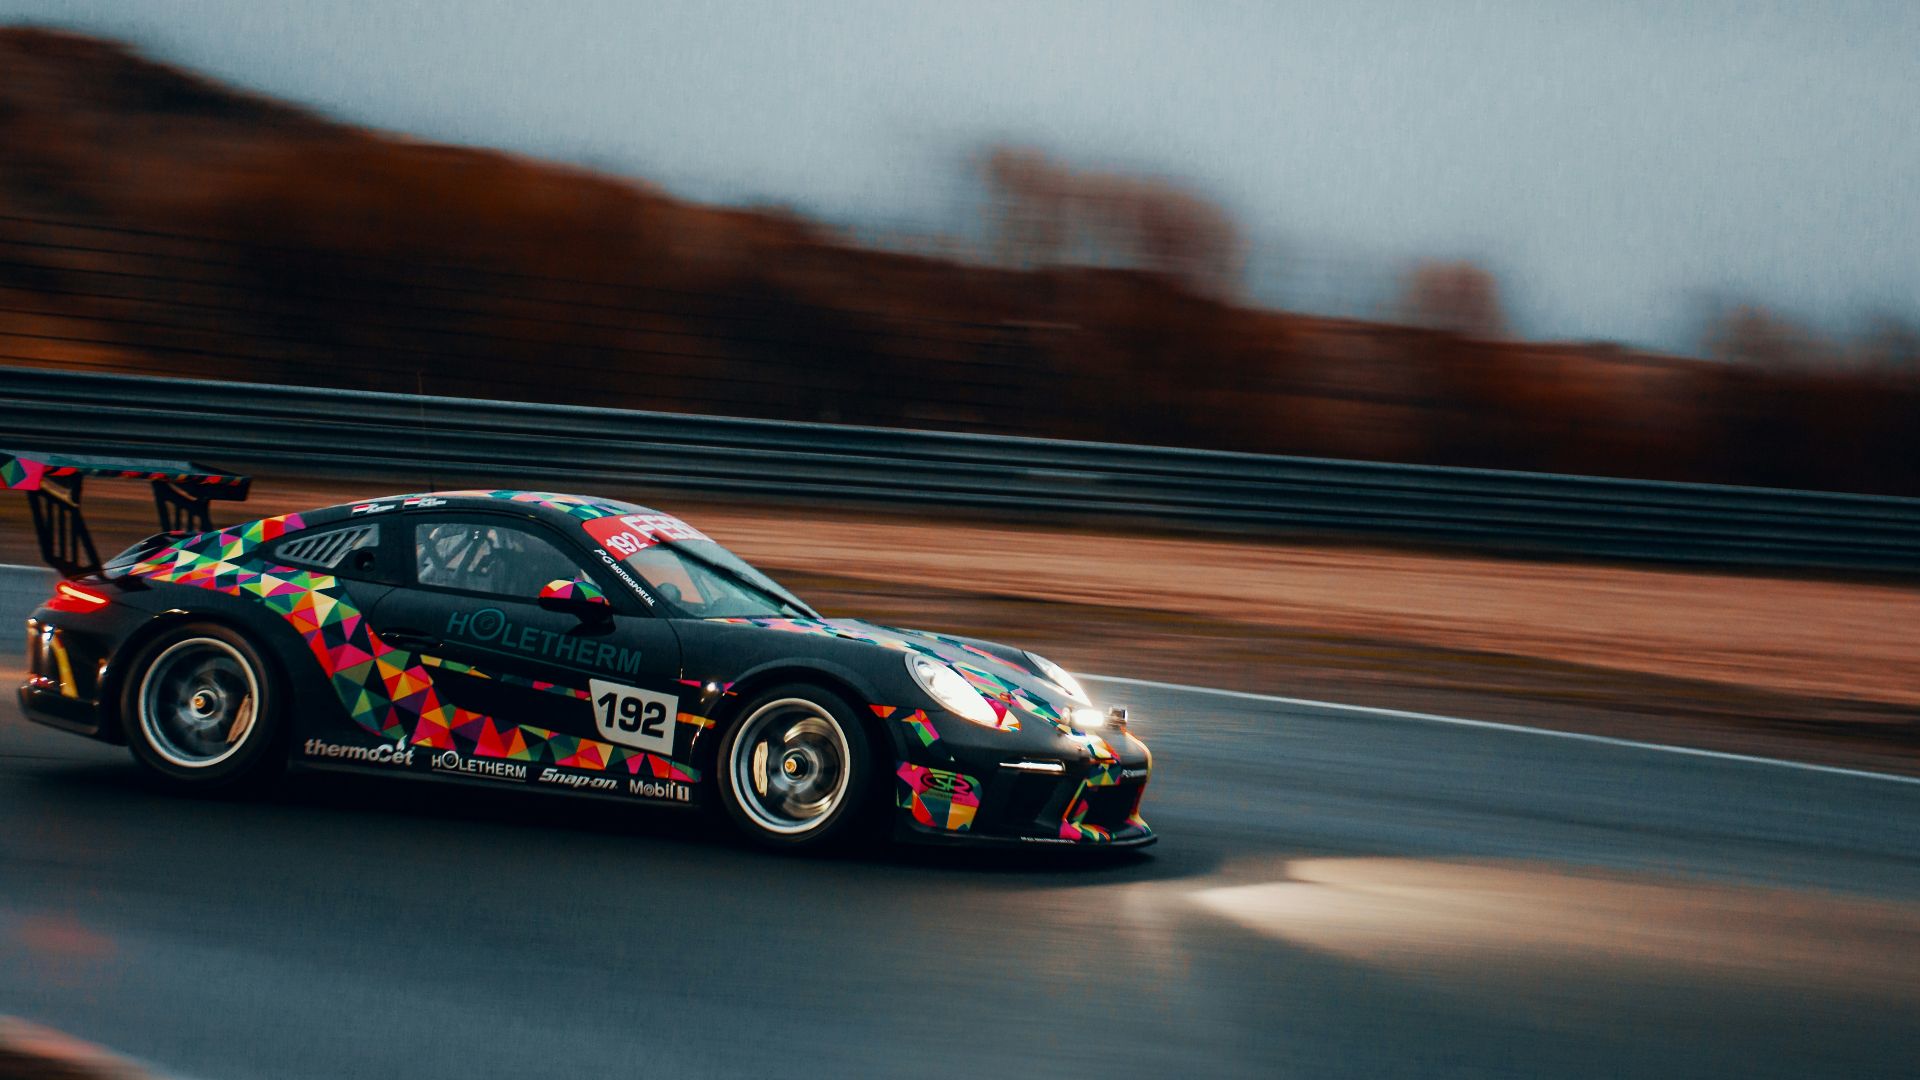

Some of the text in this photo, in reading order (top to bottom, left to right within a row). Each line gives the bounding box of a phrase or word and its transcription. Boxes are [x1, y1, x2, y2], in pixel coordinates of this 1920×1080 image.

[606, 531, 649, 555] 192
[446, 608, 642, 675] HOLETHERM
[598, 692, 667, 738] 192
[431, 750, 527, 779] HOLETHERM
[538, 767, 618, 790] Snap-on
[629, 778, 675, 799] Mobil
